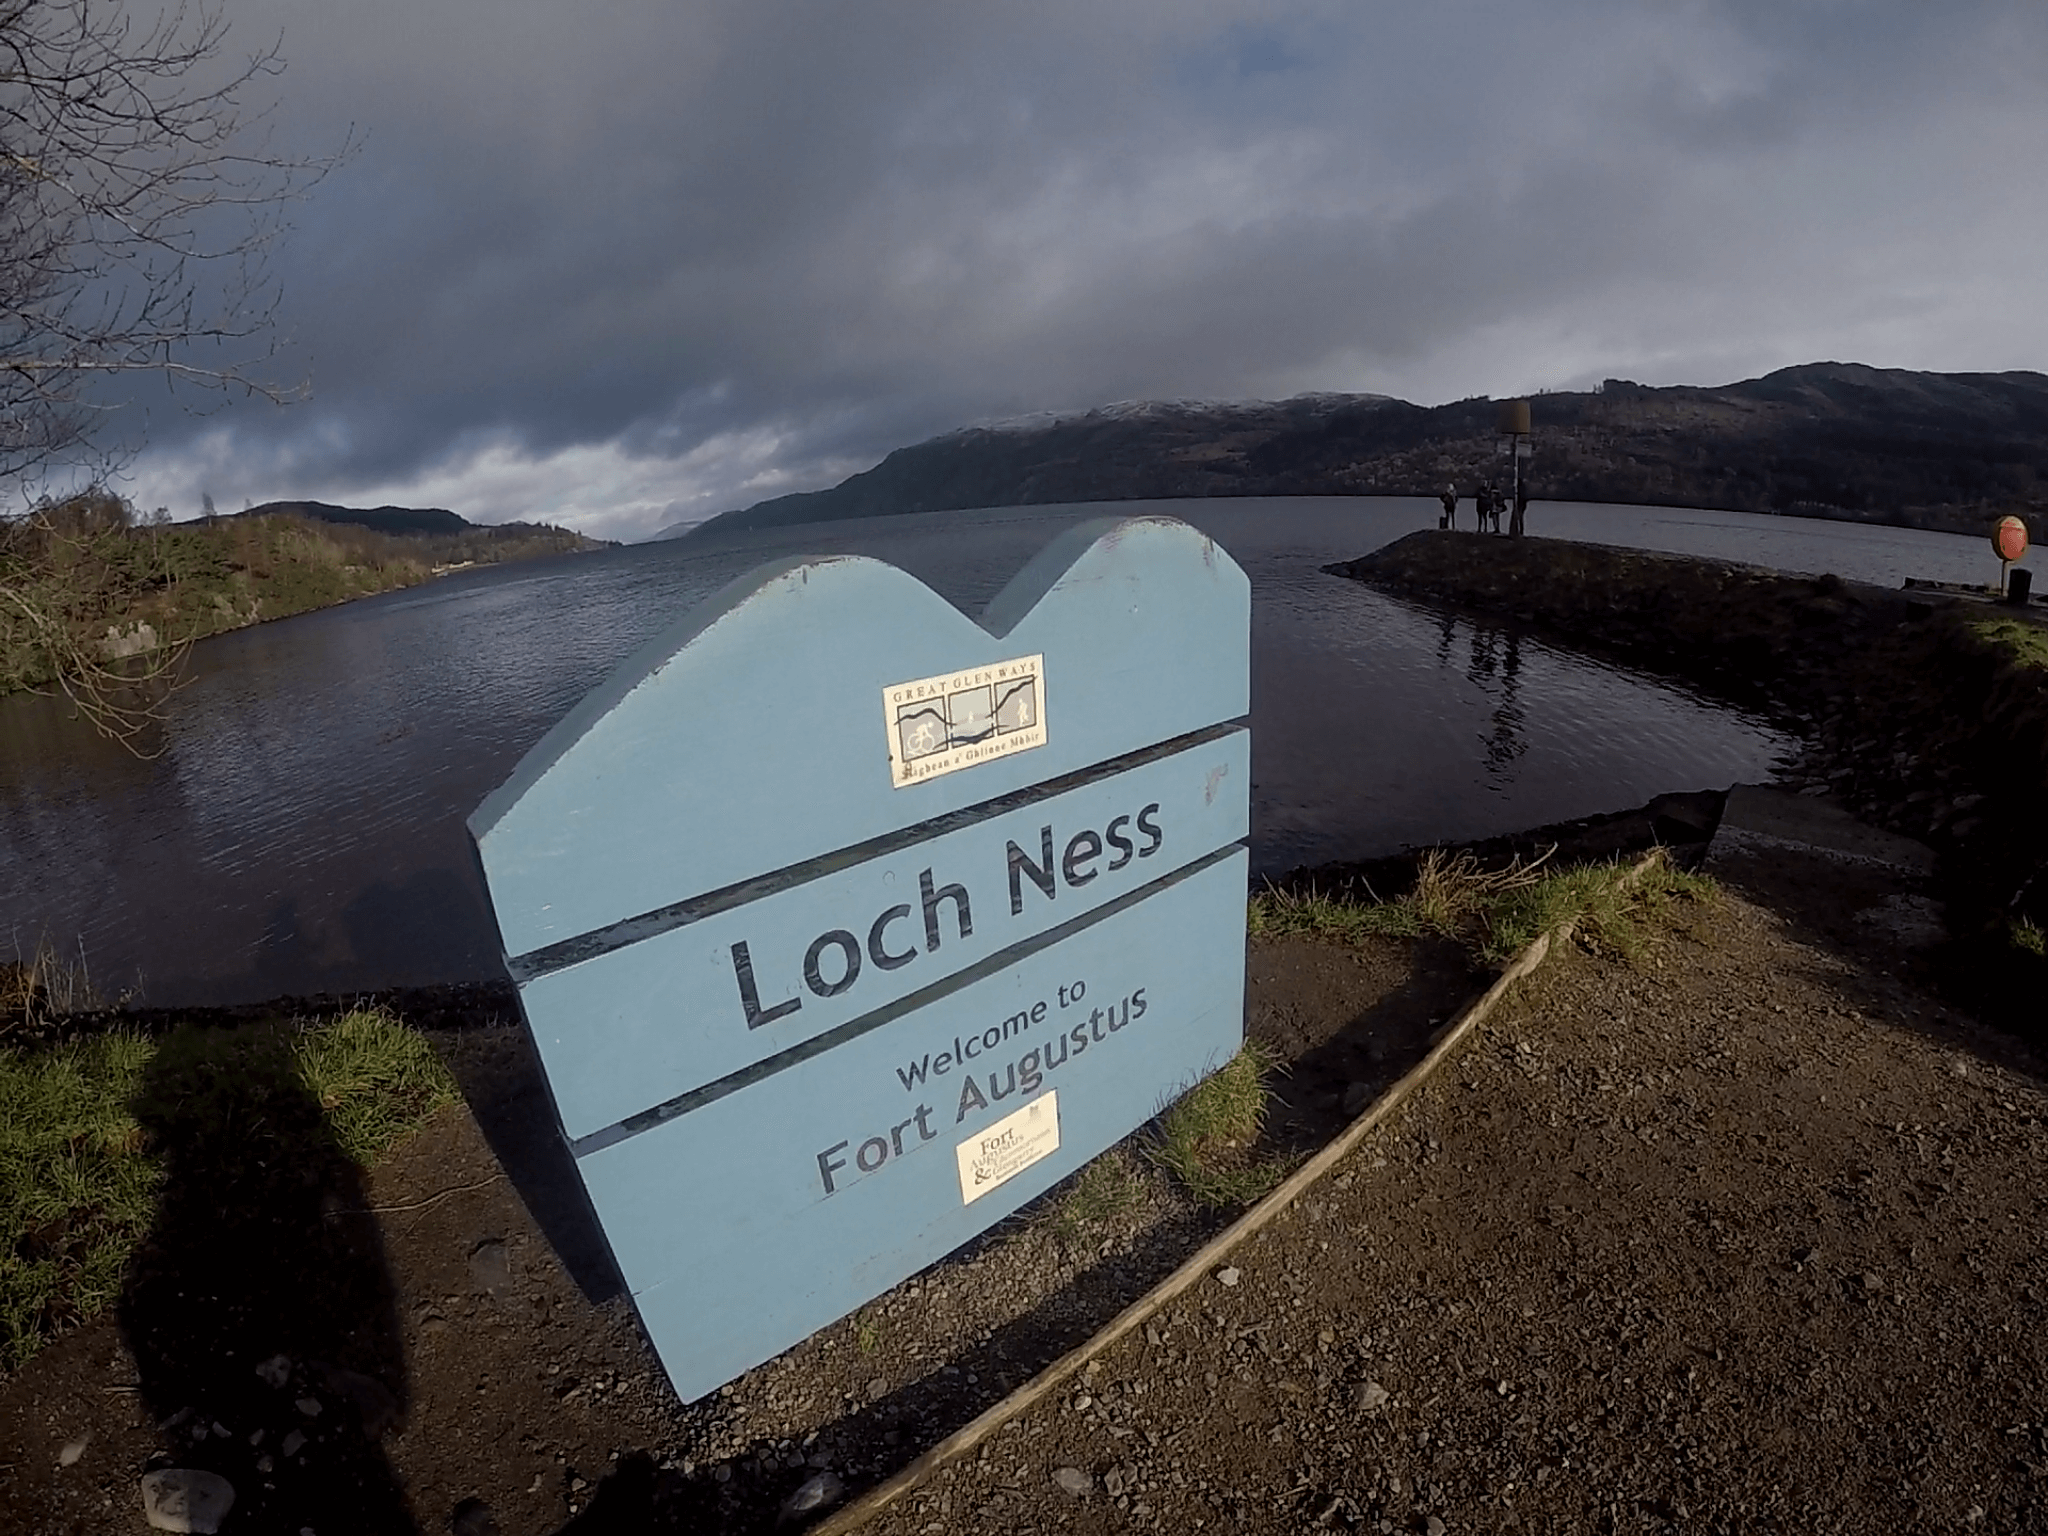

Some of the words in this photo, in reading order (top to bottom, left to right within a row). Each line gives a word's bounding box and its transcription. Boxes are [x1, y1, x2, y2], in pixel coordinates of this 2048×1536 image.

[893, 682, 947, 702] GREAT
[953, 671, 992, 688] GLEN
[999, 662, 1036, 677] WAYS
[731, 866, 973, 1031] Loch
[1006, 803, 1163, 916] Ness
[896, 999, 1047, 1092] Welcome
[1058, 980, 1086, 1010] to
[816, 1103, 938, 1194] Fort
[956, 987, 1148, 1123] Augustus
[975, 1168, 991, 1185] &
[980, 1128, 1014, 1156] Fort
